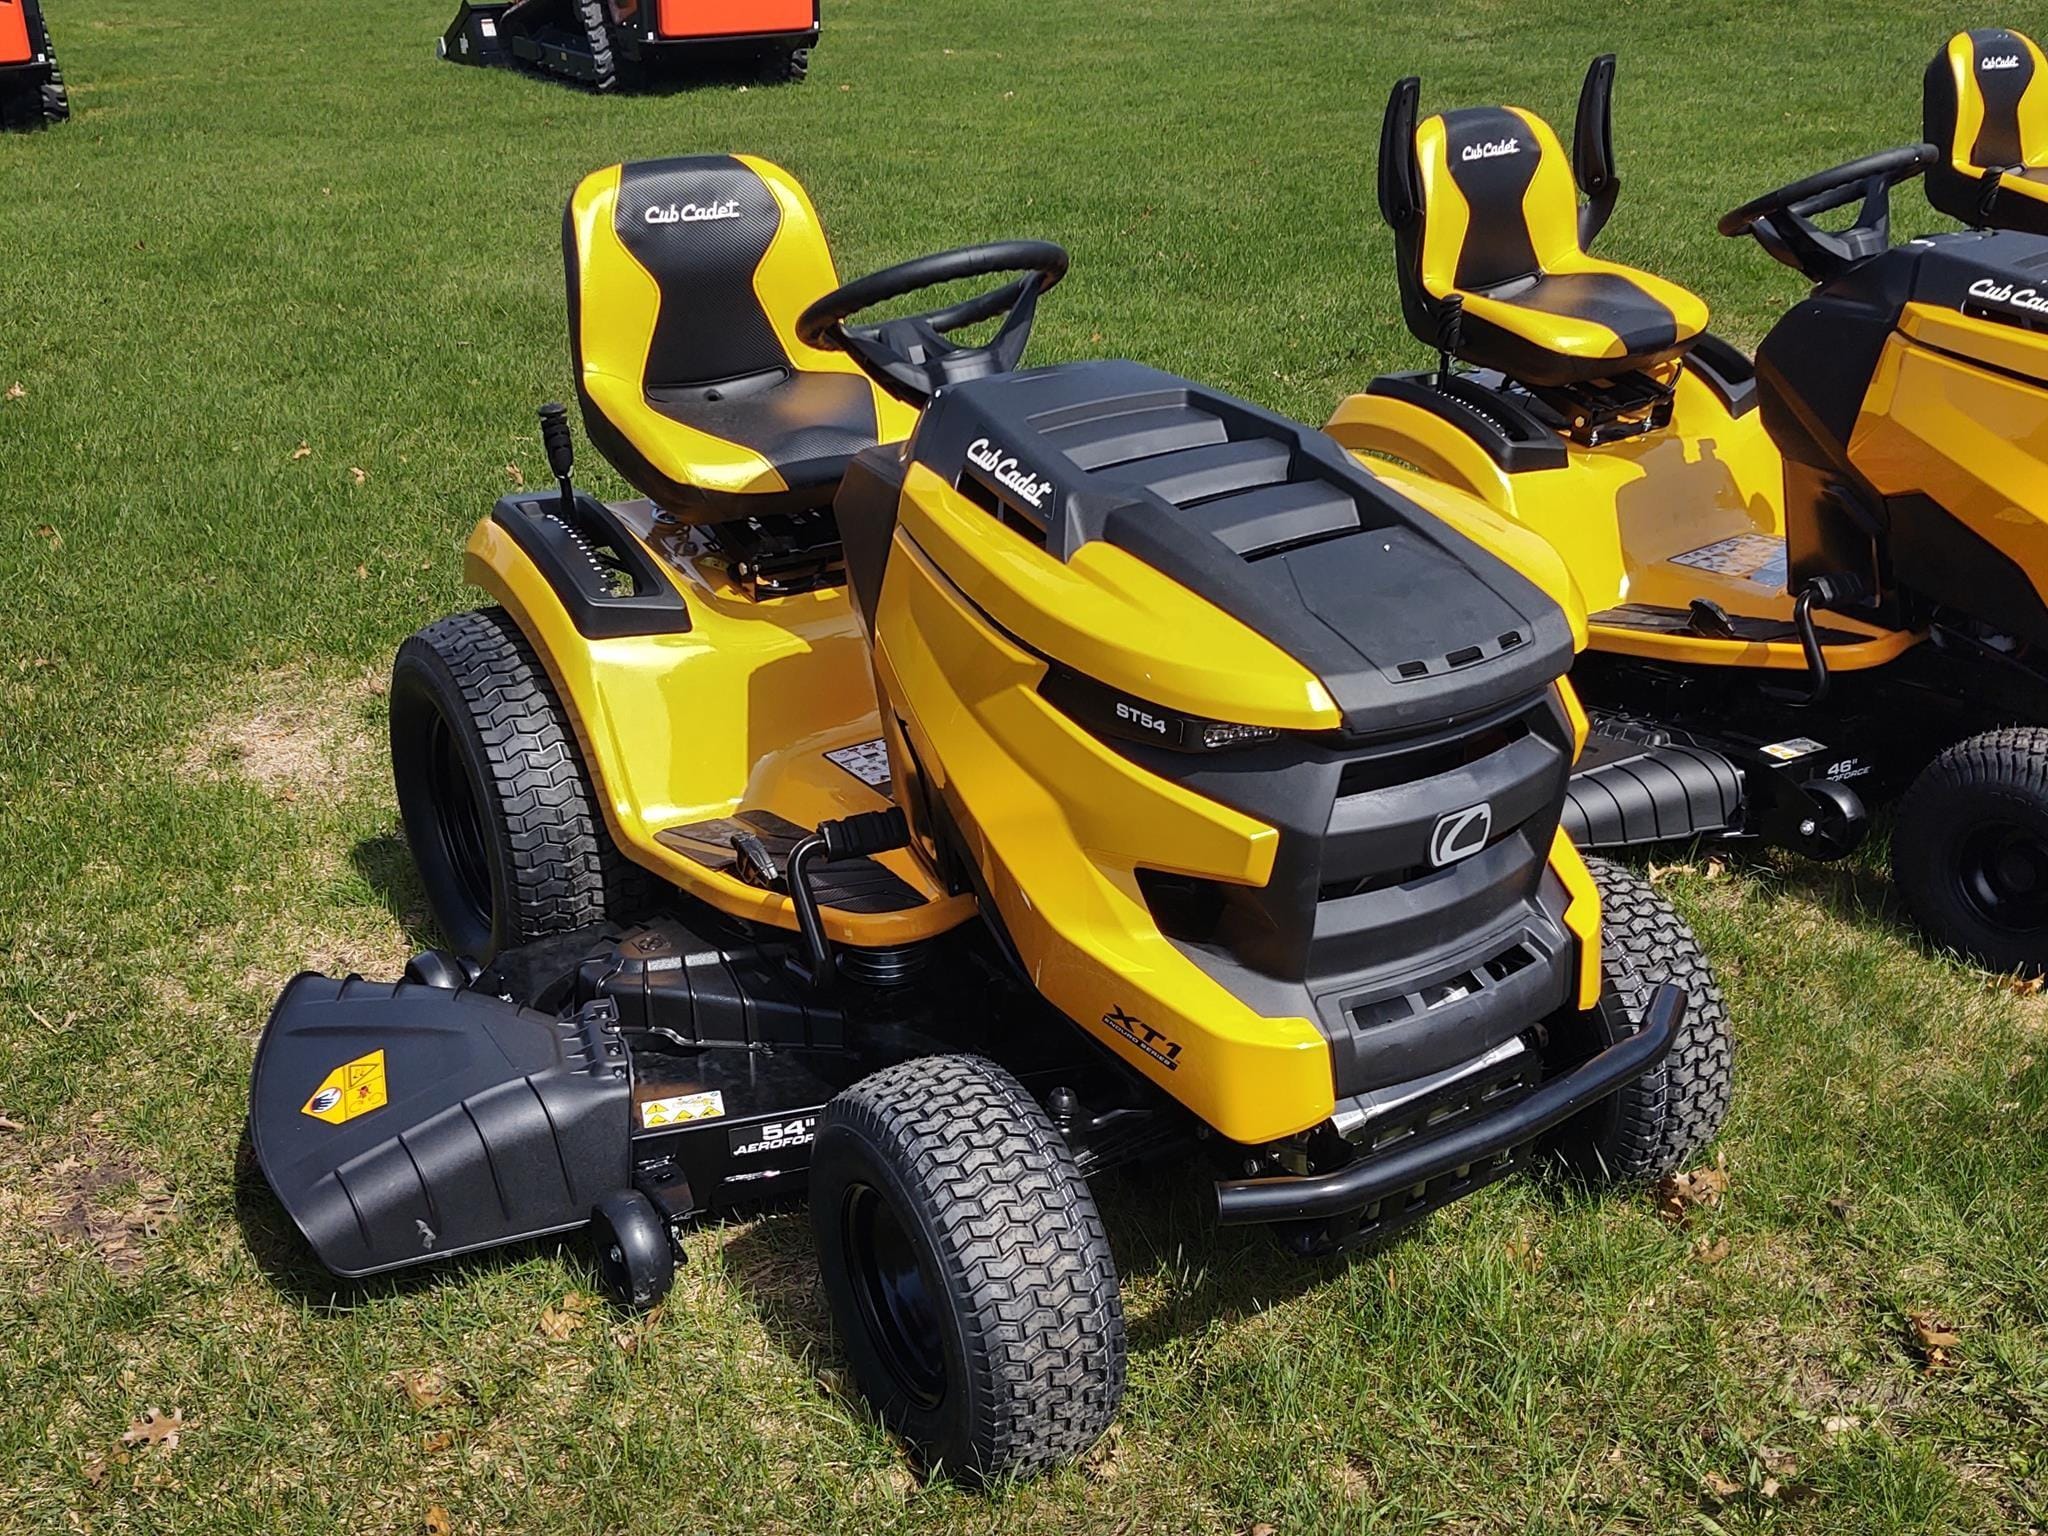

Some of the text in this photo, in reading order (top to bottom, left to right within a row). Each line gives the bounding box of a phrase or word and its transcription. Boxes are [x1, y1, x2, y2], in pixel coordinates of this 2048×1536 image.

[1462, 138, 1520, 161] Cub Cadet
[645, 200, 740, 223] Cub Cadet
[1968, 279, 2014, 302] Cub
[967, 438, 1052, 507] Cub Cadet
[1116, 702, 1166, 734] ST54
[1827, 758, 1858, 775] 46"
[1103, 1016, 1172, 1067] ENDURO SERIES
[1105, 1003, 1182, 1060] XT1
[762, 1118, 815, 1141] 54"
